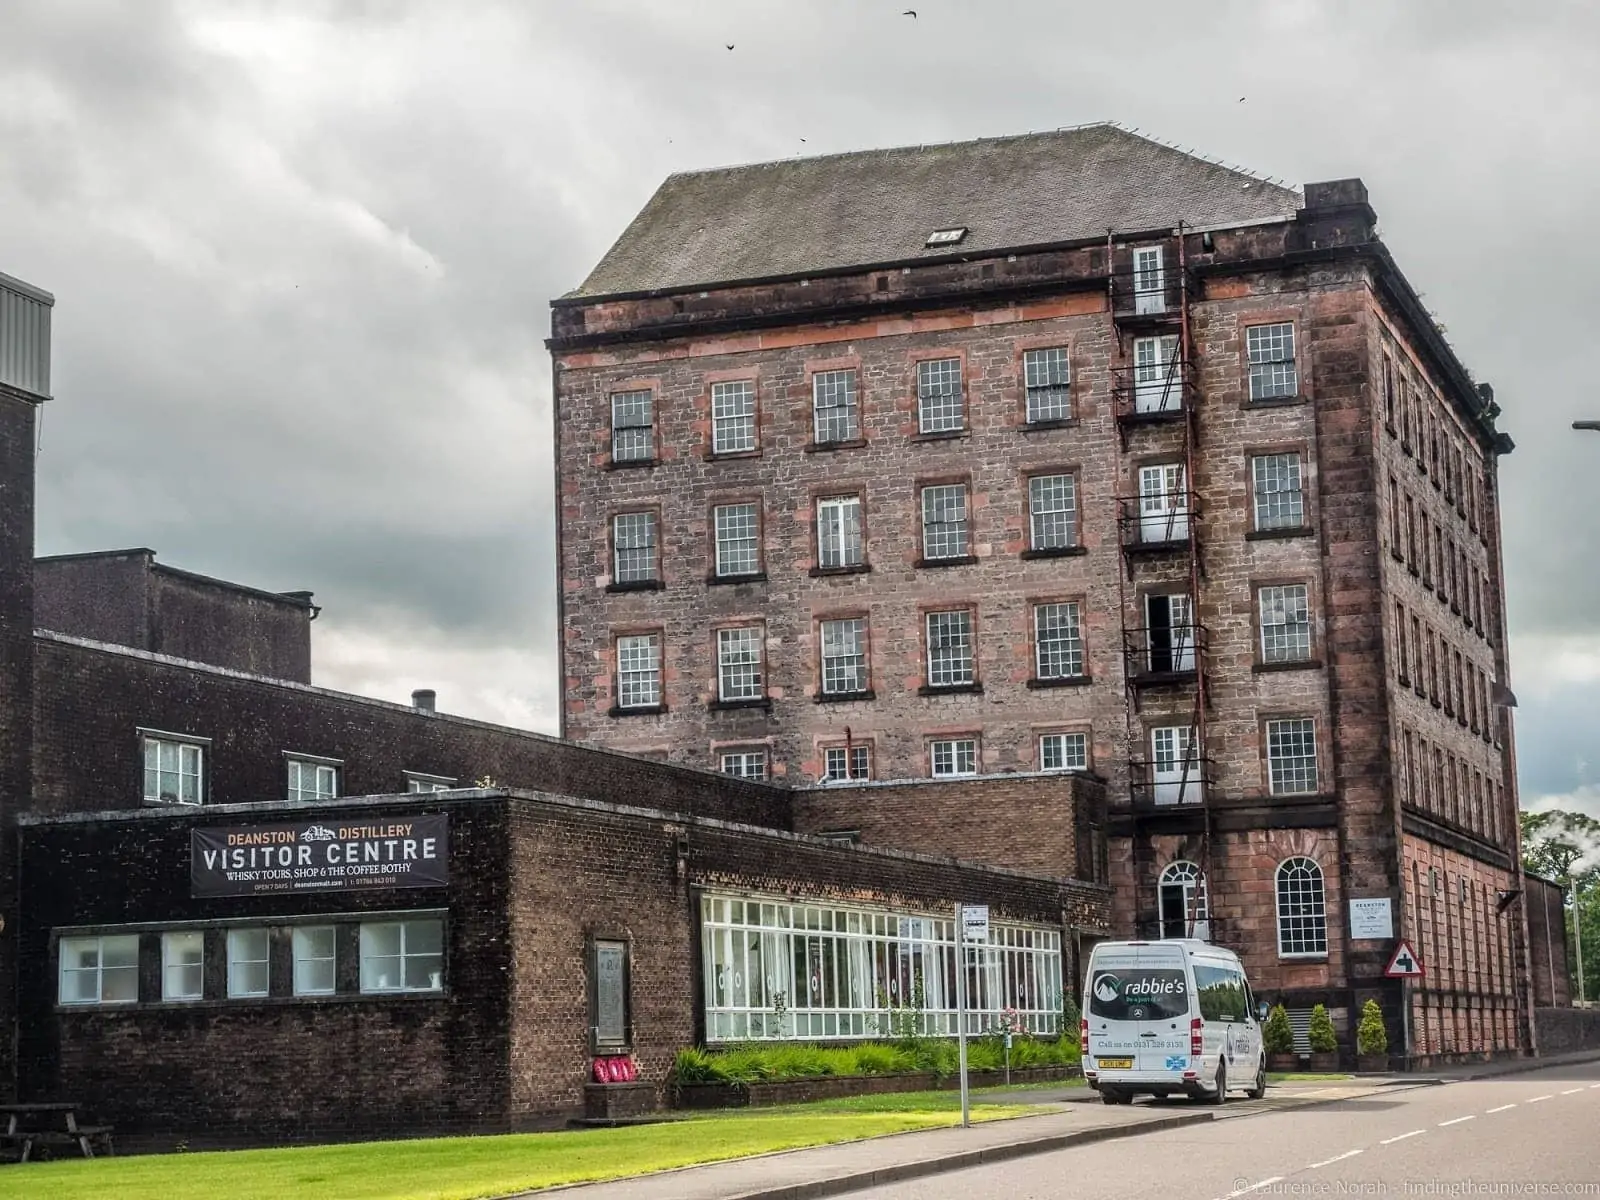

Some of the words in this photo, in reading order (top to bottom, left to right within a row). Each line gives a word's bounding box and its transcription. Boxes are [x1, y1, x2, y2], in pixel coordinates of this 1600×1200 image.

[228, 831, 296, 846] DEANSTON
[339, 824, 413, 840] DISTILLERY
[203, 845, 313, 870] VISITOR
[326, 838, 437, 864] CENTRE
[226, 871, 261, 881] WHISKY
[262, 869, 293, 880] TOURS,
[294, 868, 320, 878] SHOP
[320, 867, 327, 877] &
[328, 866, 346, 876] THE
[346, 864, 380, 875] COFFEE
[381, 863, 413, 874] BOTHY
[1125, 977, 1185, 995] rabbie's
[1133, 1041, 1150, 1049] 0131
